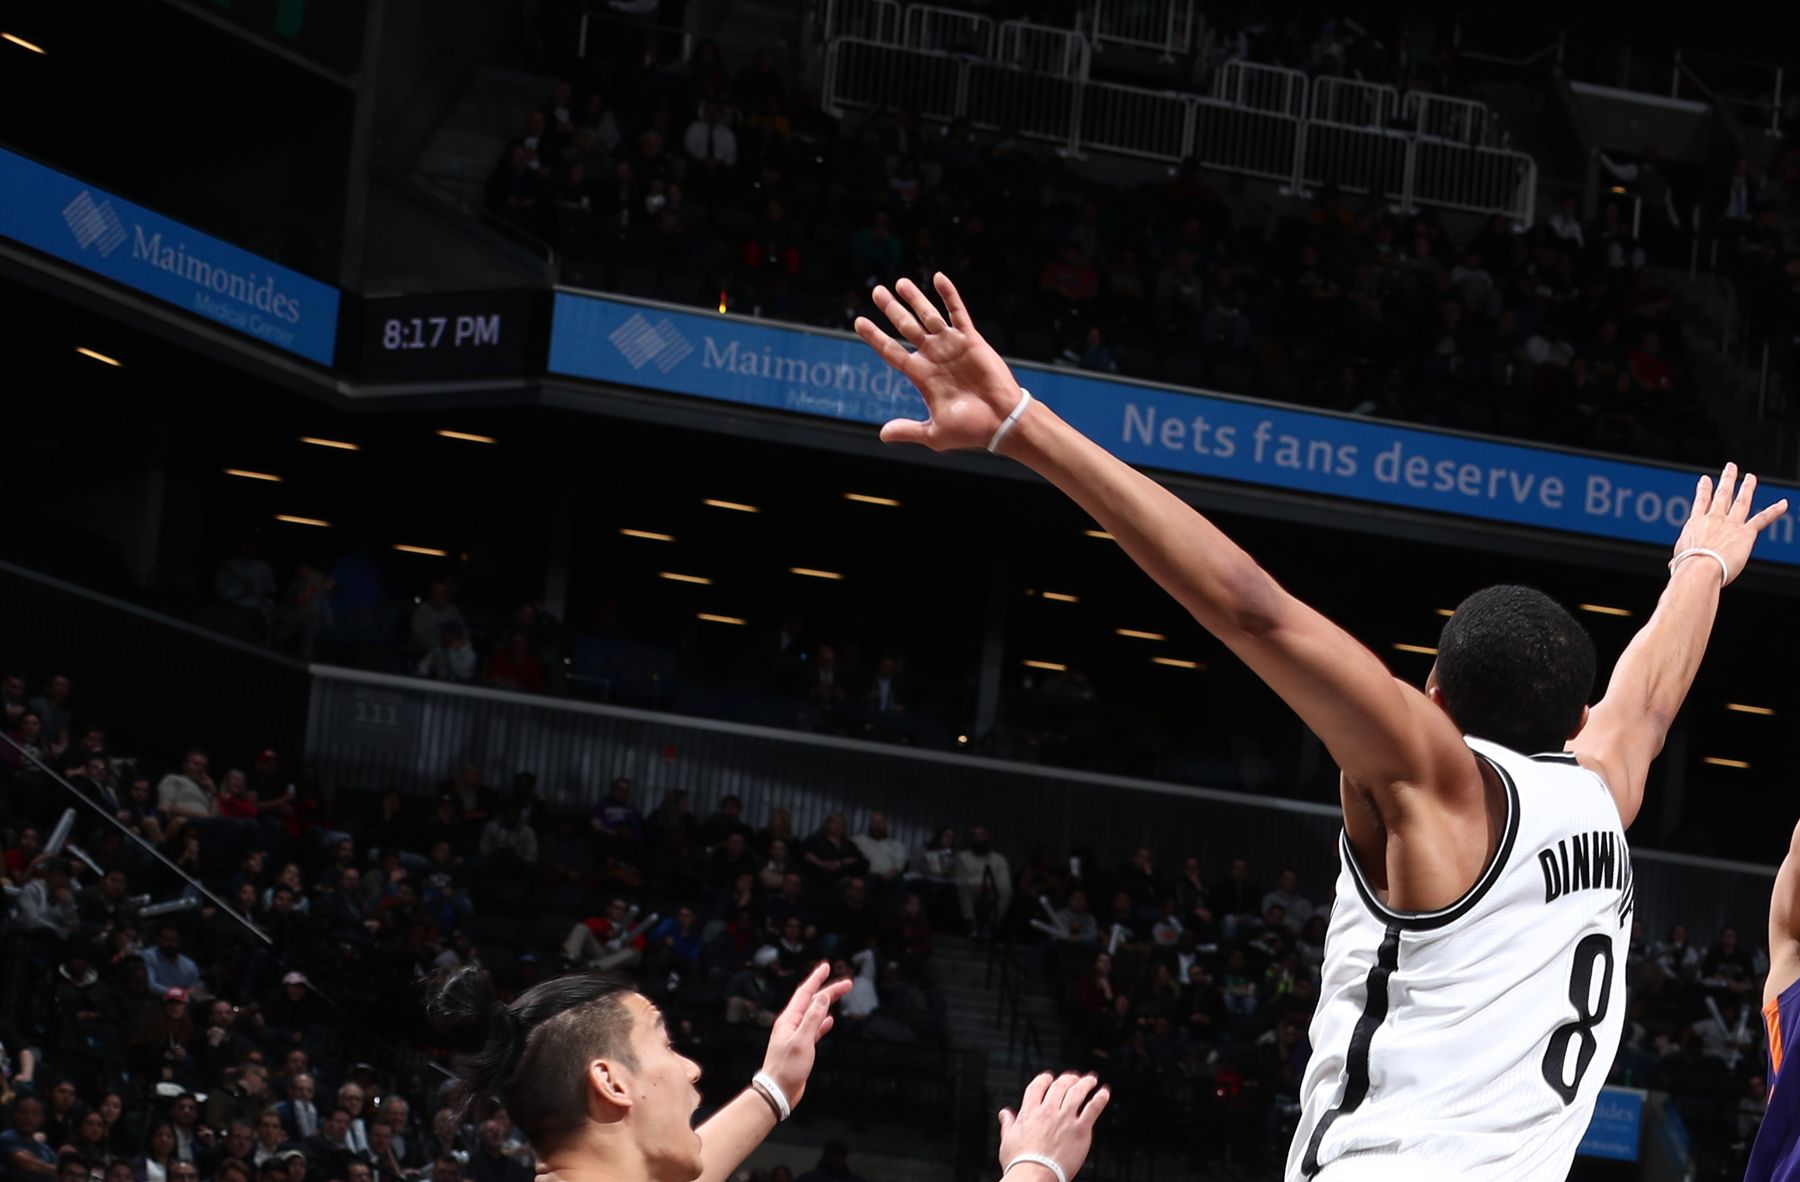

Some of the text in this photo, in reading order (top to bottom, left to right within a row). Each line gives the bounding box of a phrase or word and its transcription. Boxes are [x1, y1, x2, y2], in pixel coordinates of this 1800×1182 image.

[132, 224, 301, 324] Maimonides
[383, 314, 501, 350] 8:17 PM
[701, 335, 916, 401] Maimonide
[1122, 404, 1236, 460] Nets
[1254, 415, 1358, 478] fans
[1374, 440, 1565, 510] deserve
[355, 701, 398, 727] 111
[1541, 932, 1614, 1106] 8
